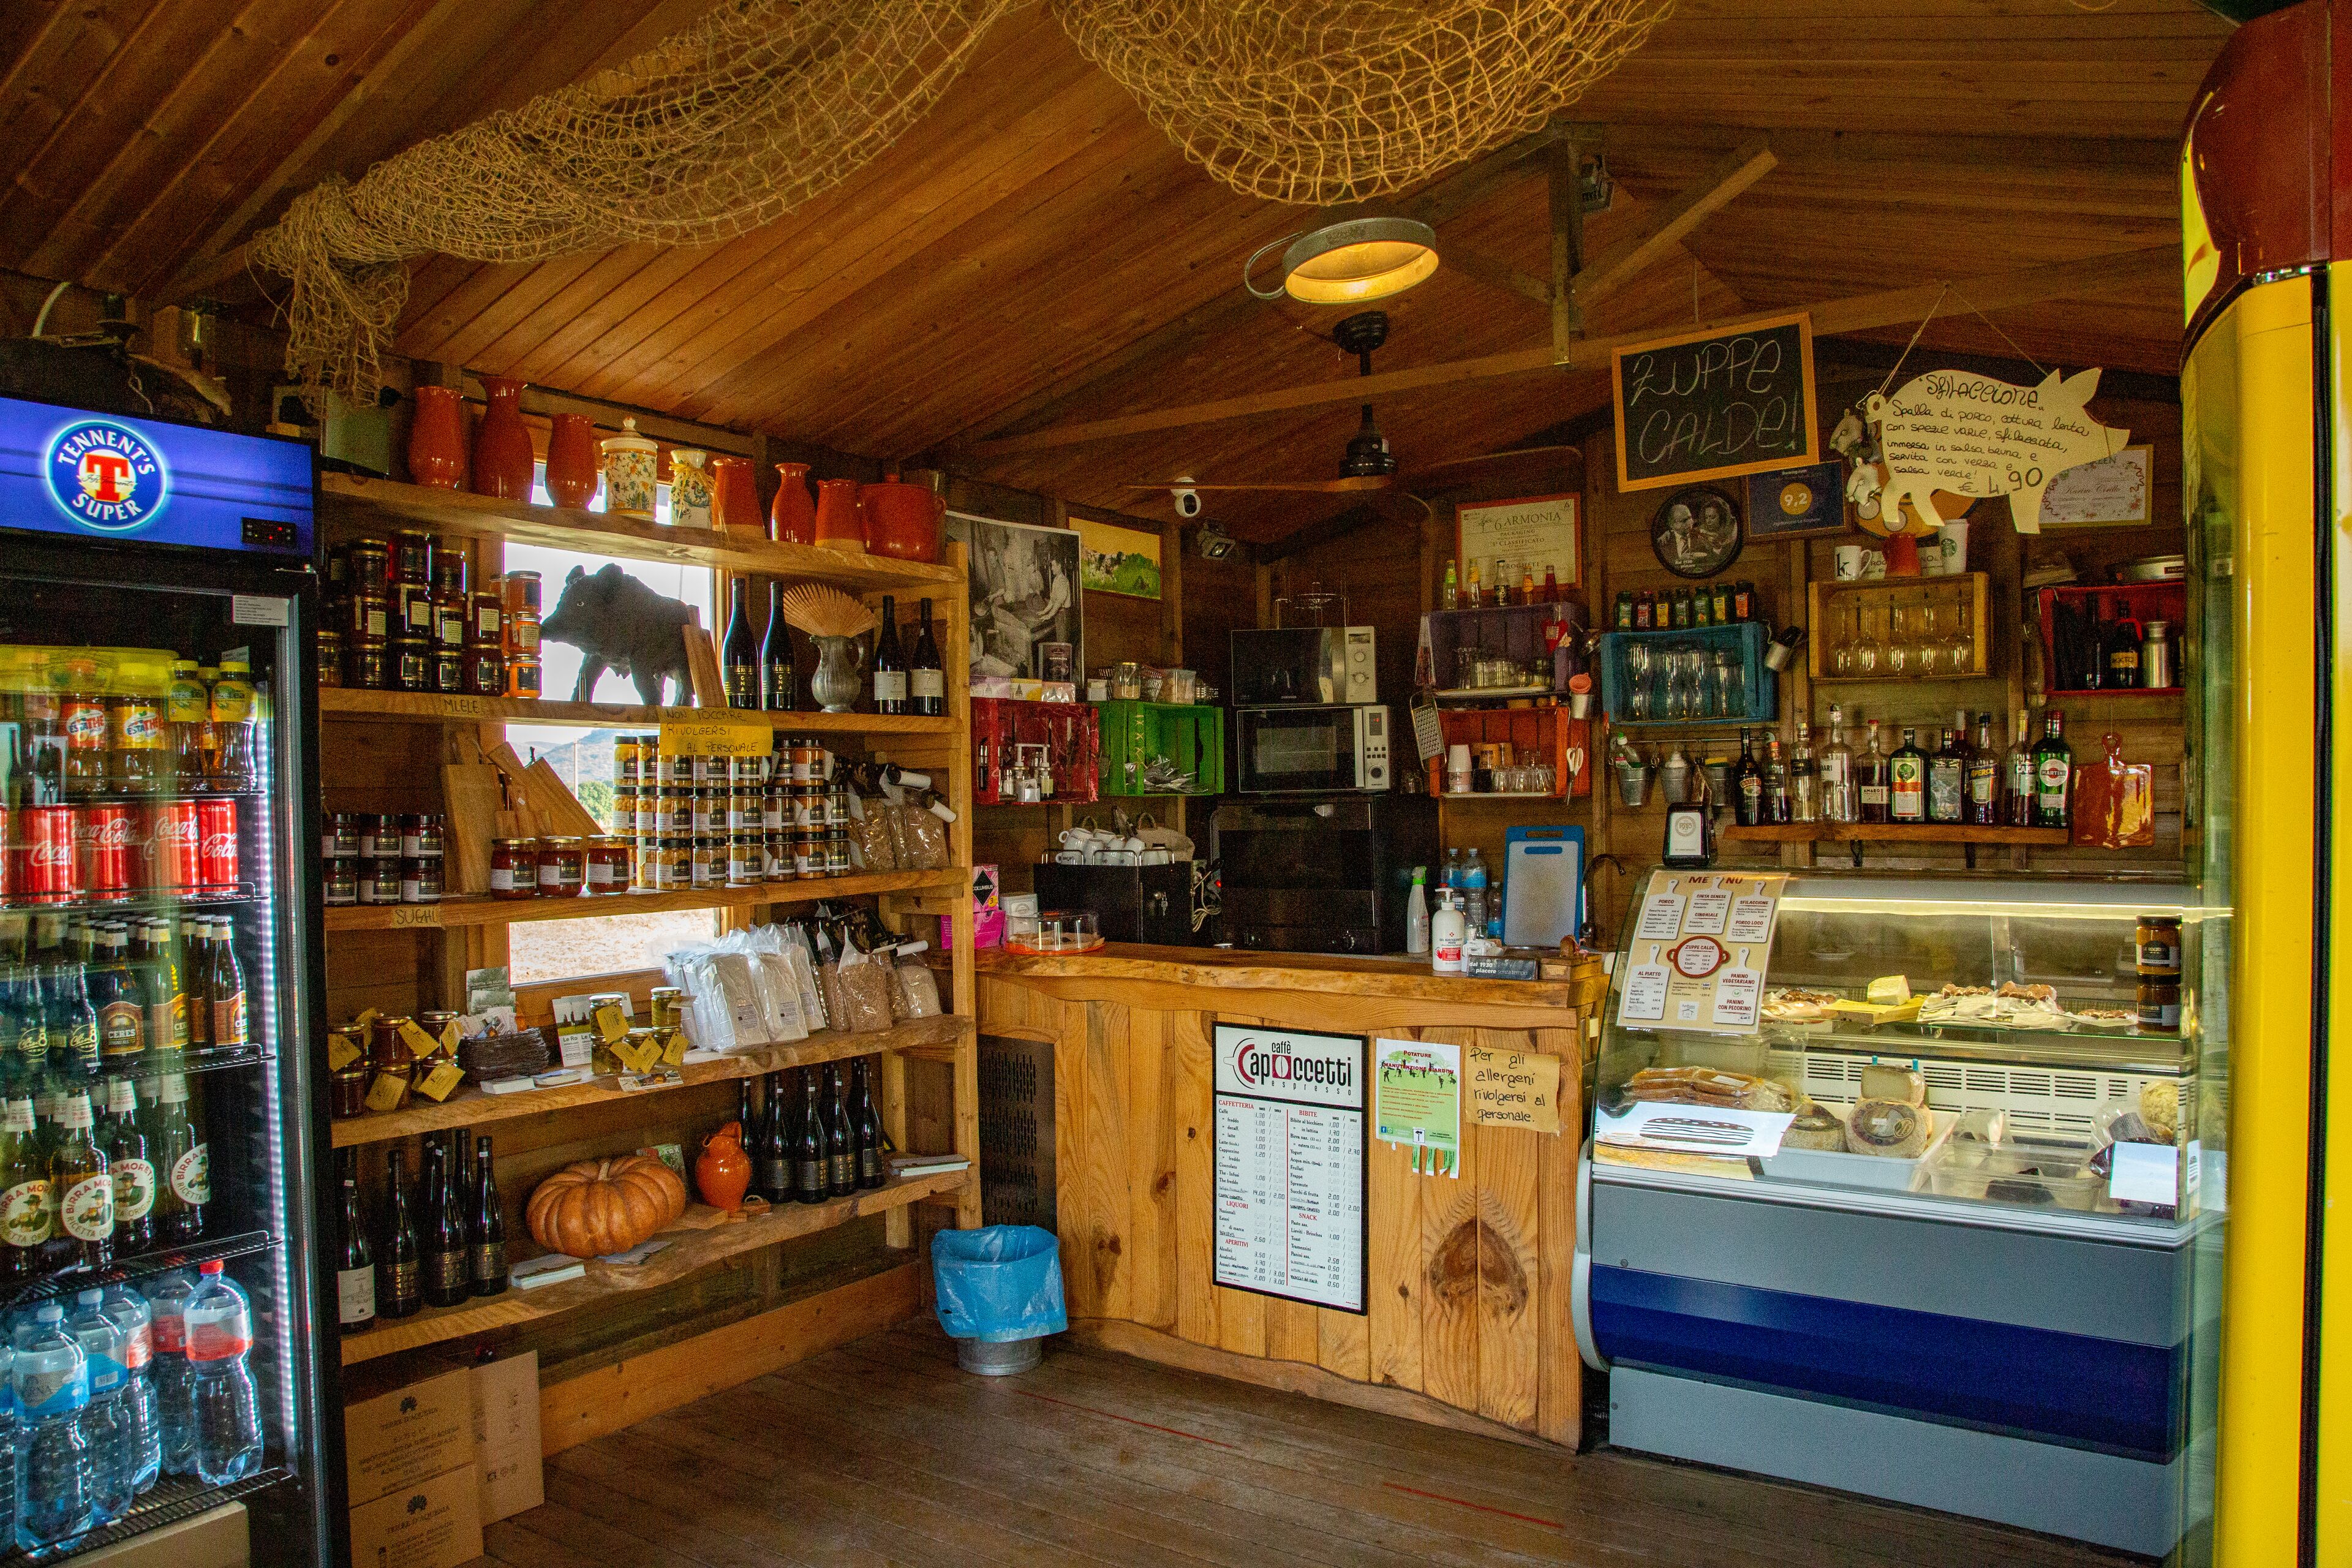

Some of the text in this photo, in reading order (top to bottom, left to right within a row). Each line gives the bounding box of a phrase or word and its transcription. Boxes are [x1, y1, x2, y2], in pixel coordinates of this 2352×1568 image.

[1941, 407, 1954, 418] di
[1886, 423, 1905, 432] con
[58, 429, 156, 475] TENNENT'S
[1935, 443, 1947, 453] in
[1950, 442, 1986, 454] salsa
[1936, 456, 1957, 465] con
[1893, 465, 1930, 476] salsa
[72, 493, 143, 521] SUPER
[666, 709, 747, 722] NON TOCCARE
[666, 722, 731, 736] RIVOLGERSI
[687, 741, 759, 752] AL PERSONALE
[1476, 968, 1497, 976] piacere
[107, 1028, 135, 1039] CERES
[1272, 1040, 1292, 1055] caffè
[1470, 1047, 1526, 1069] Per gli
[1475, 1069, 1536, 1088] allergeni
[1474, 1088, 1546, 1107] rivolgersi al
[1218, 1099, 1254, 1109] CAFFETTERIA
[1298, 1109, 1318, 1118] BIBITE
[176, 1153, 199, 1180] BIRRA
[65, 1185, 91, 1214] BIRRA
[1226, 1200, 1249, 1210] LIQUORI
[1298, 1212, 1318, 1221] SNACK
[1306, 1229, 1323, 1238] Brioches
[1225, 1238, 1249, 1248] APERITIVI
[1291, 1243, 1312, 1252] Tramezzini
